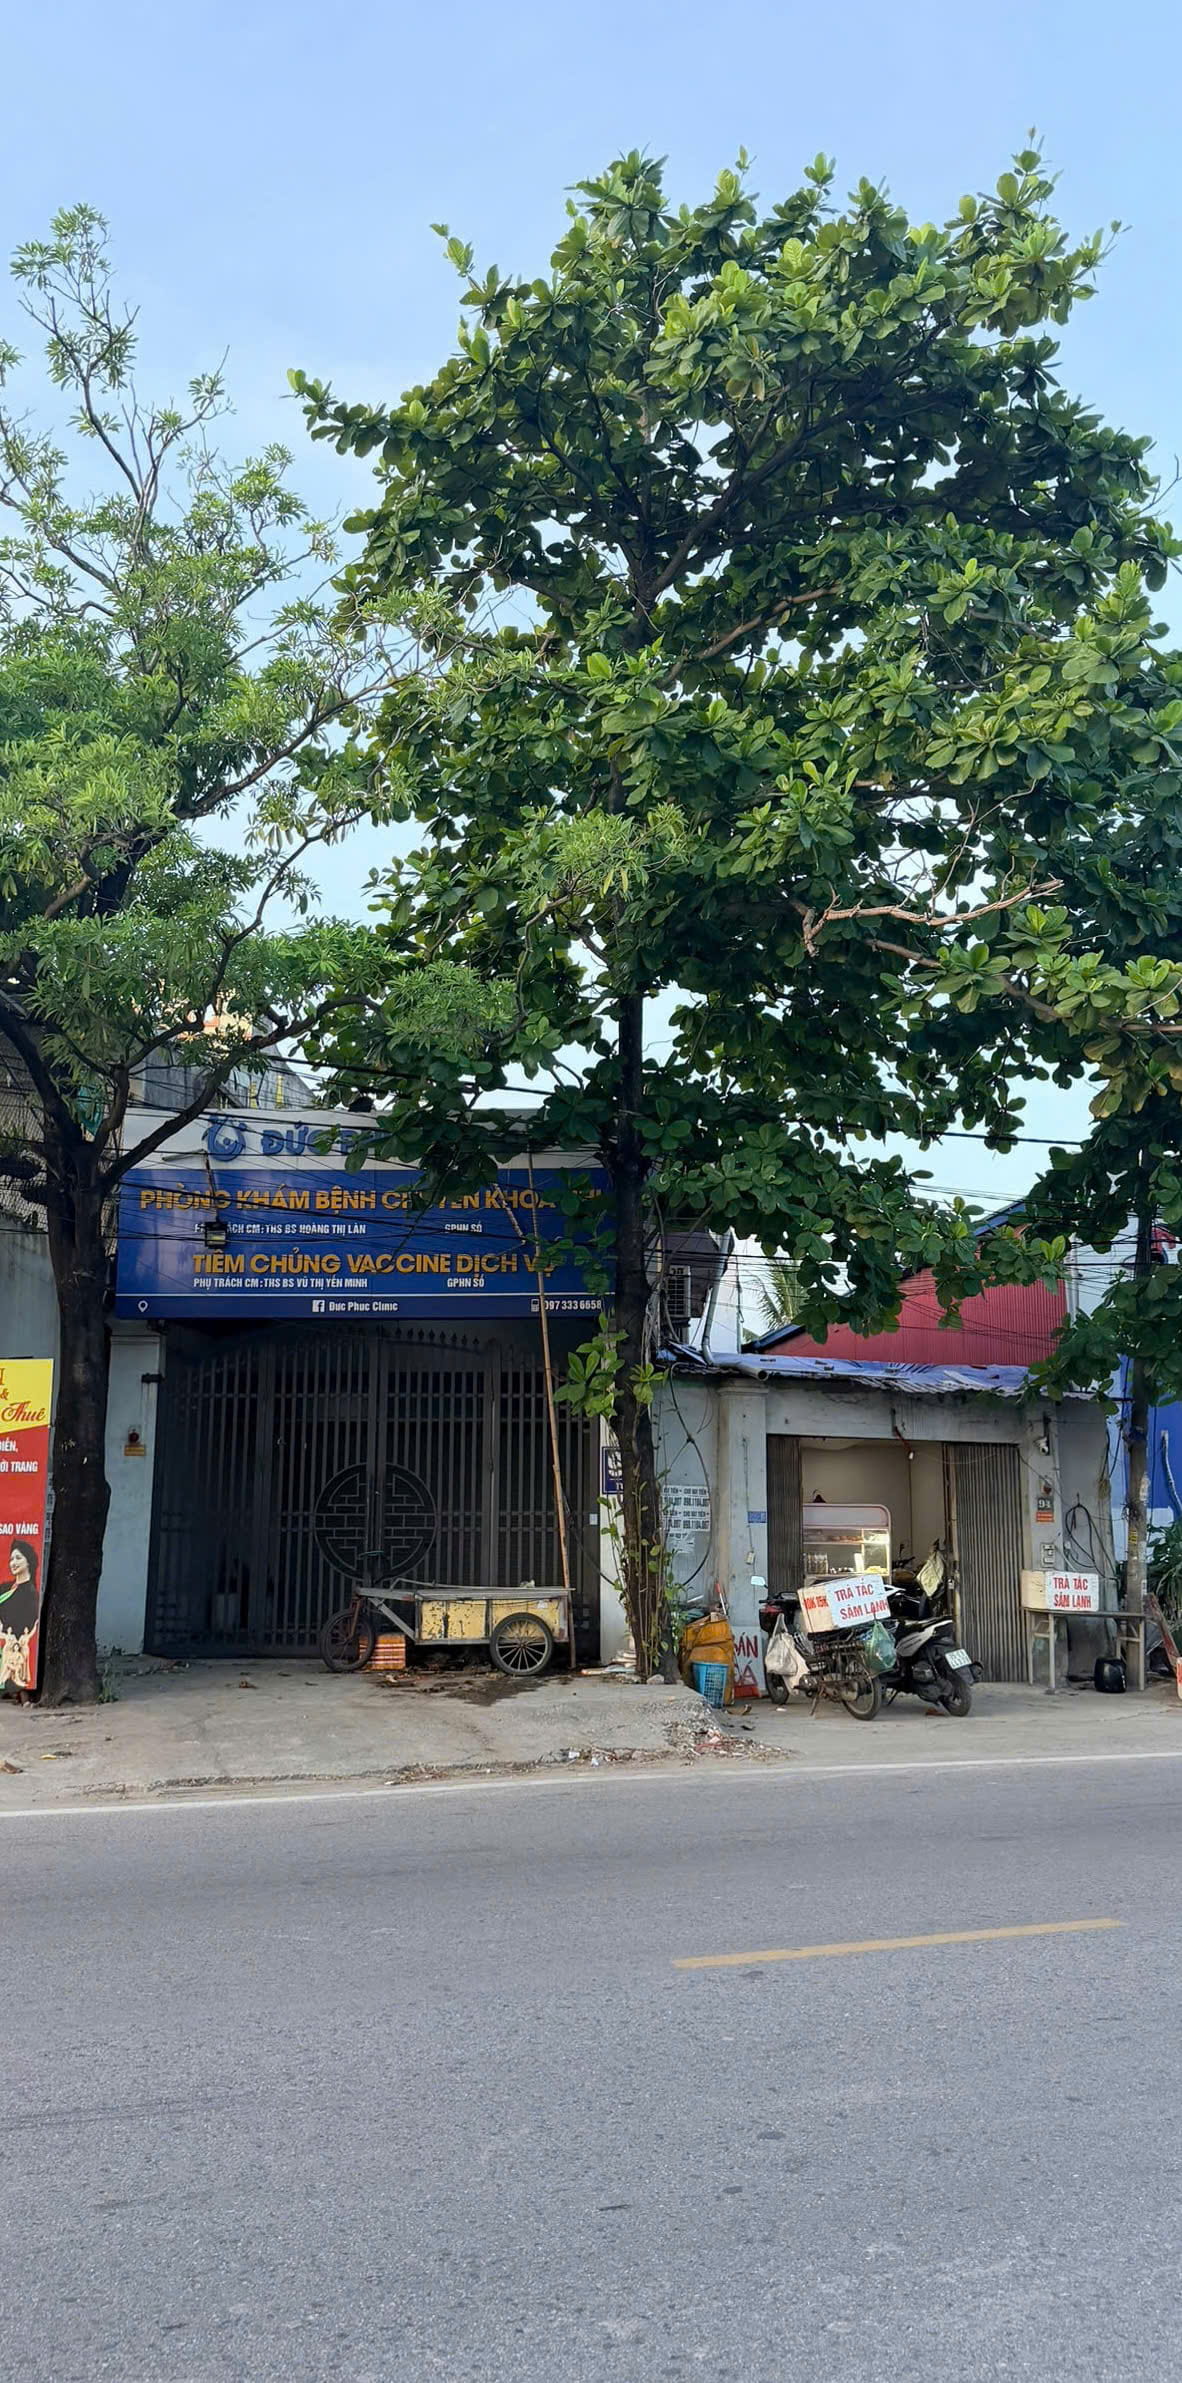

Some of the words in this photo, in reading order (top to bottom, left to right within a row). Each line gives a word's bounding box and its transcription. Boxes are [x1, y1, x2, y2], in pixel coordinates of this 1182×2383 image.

[236, 1184, 309, 1210] KHÁM
[316, 1185, 376, 1214] BỆNH
[285, 1223, 297, 1234] BS
[332, 1223, 346, 1236] THỊ
[192, 1248, 245, 1274] TIÊM
[250, 1246, 341, 1275] CHỦNG
[347, 1253, 451, 1275] VACCINE
[456, 1254, 518, 1279] DỊCH
[523, 1254, 555, 1277] V
[193, 1277, 212, 1291] PHỤ
[214, 1275, 242, 1289] TRÁCH
[283, 1277, 295, 1289] BS
[310, 1277, 324, 1291] THỊ
[345, 1278, 368, 1289] MINH
[447, 1278, 471, 1289] GPHN
[372, 1301, 399, 1311] Clinic
[561, 1300, 579, 1311] 333
[1, 1401, 46, 1422] Thuê
[11, 1461, 39, 1473] TRANG
[15, 1520, 39, 1535] VÀNG
